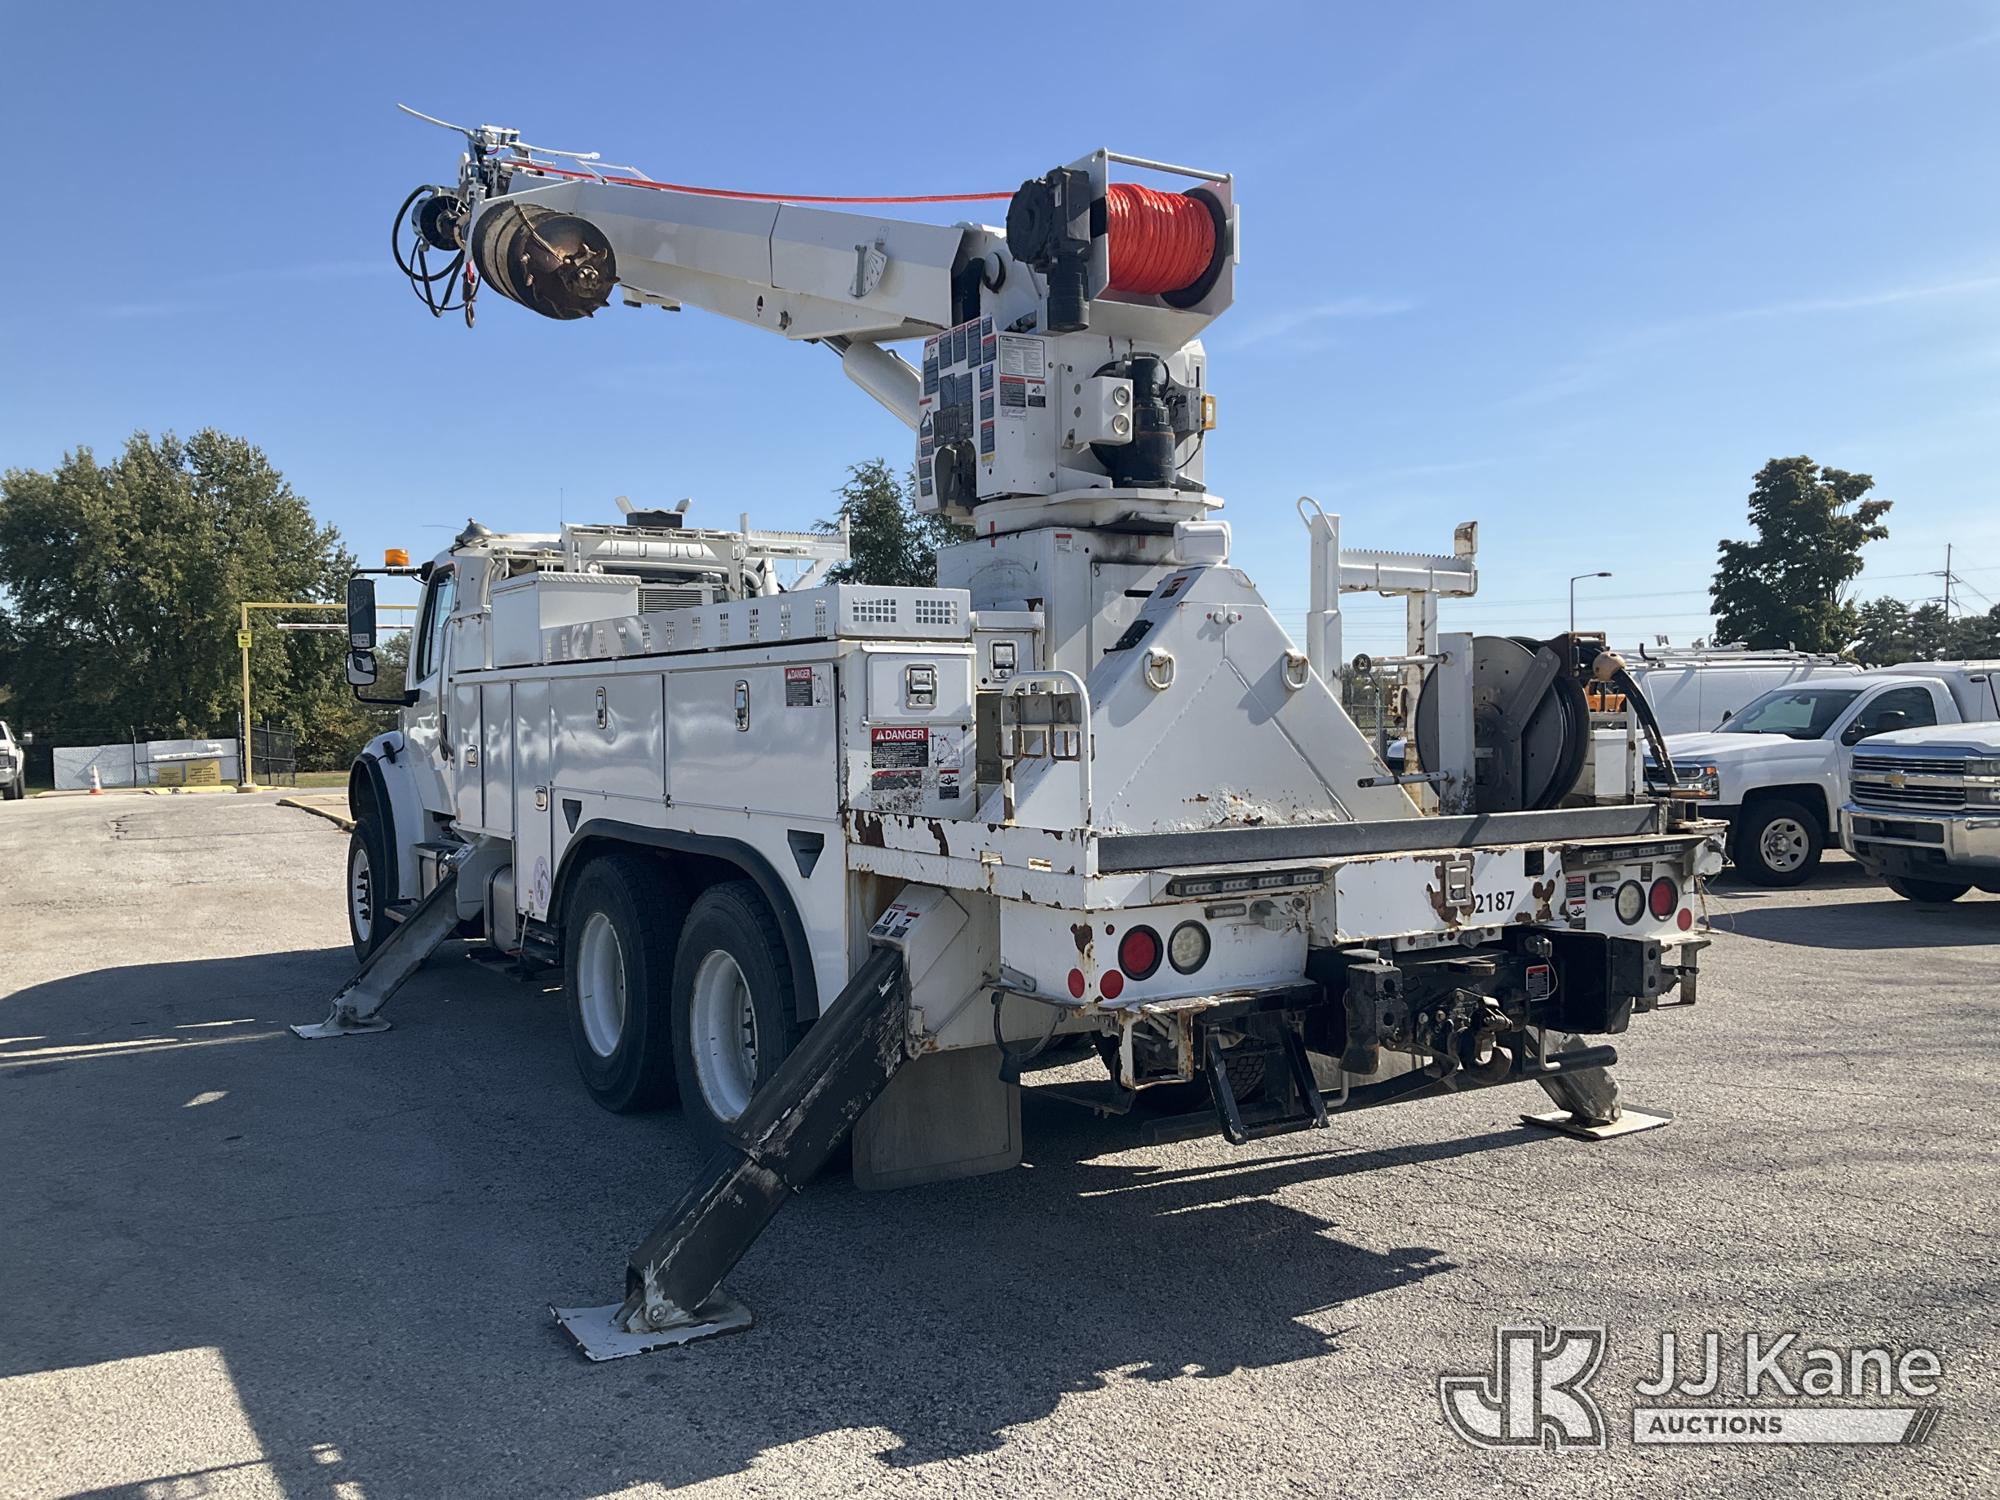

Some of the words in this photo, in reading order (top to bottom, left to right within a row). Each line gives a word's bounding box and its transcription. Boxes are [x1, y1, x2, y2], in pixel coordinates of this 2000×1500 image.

[791, 669, 810, 679] DANGER
[885, 729, 924, 740] DANGER
[1475, 891, 1514, 914] 2187
